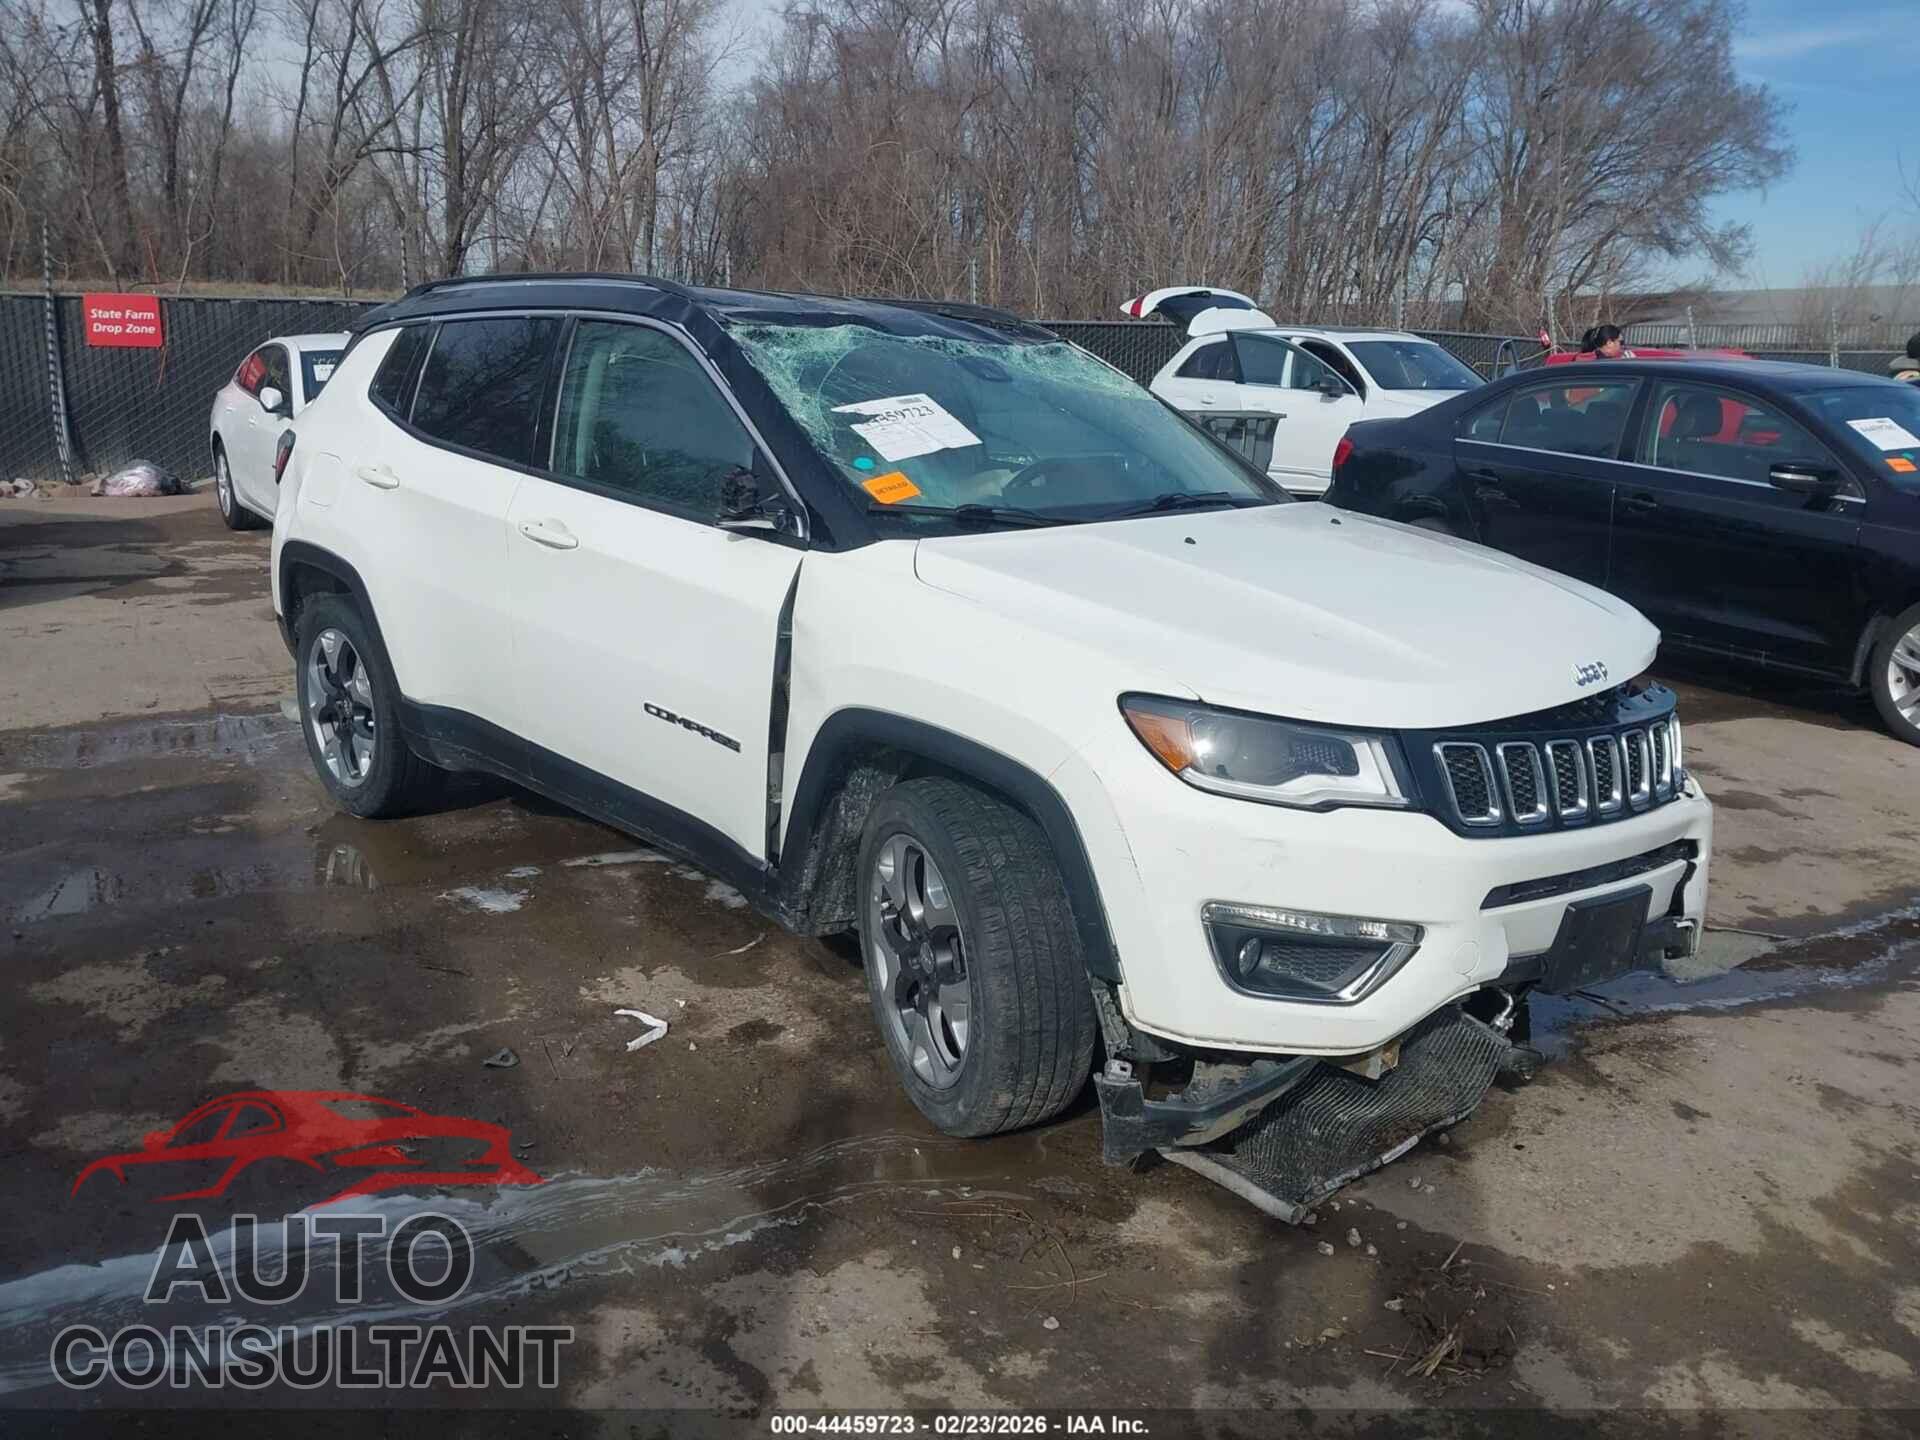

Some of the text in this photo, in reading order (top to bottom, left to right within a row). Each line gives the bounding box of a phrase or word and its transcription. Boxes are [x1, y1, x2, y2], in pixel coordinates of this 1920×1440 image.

[90, 308, 155, 319] State Farm
[92, 322, 156, 335] Drop Zone
[1572, 661, 1608, 687] Jeep
[643, 702, 741, 753] COMPASS
